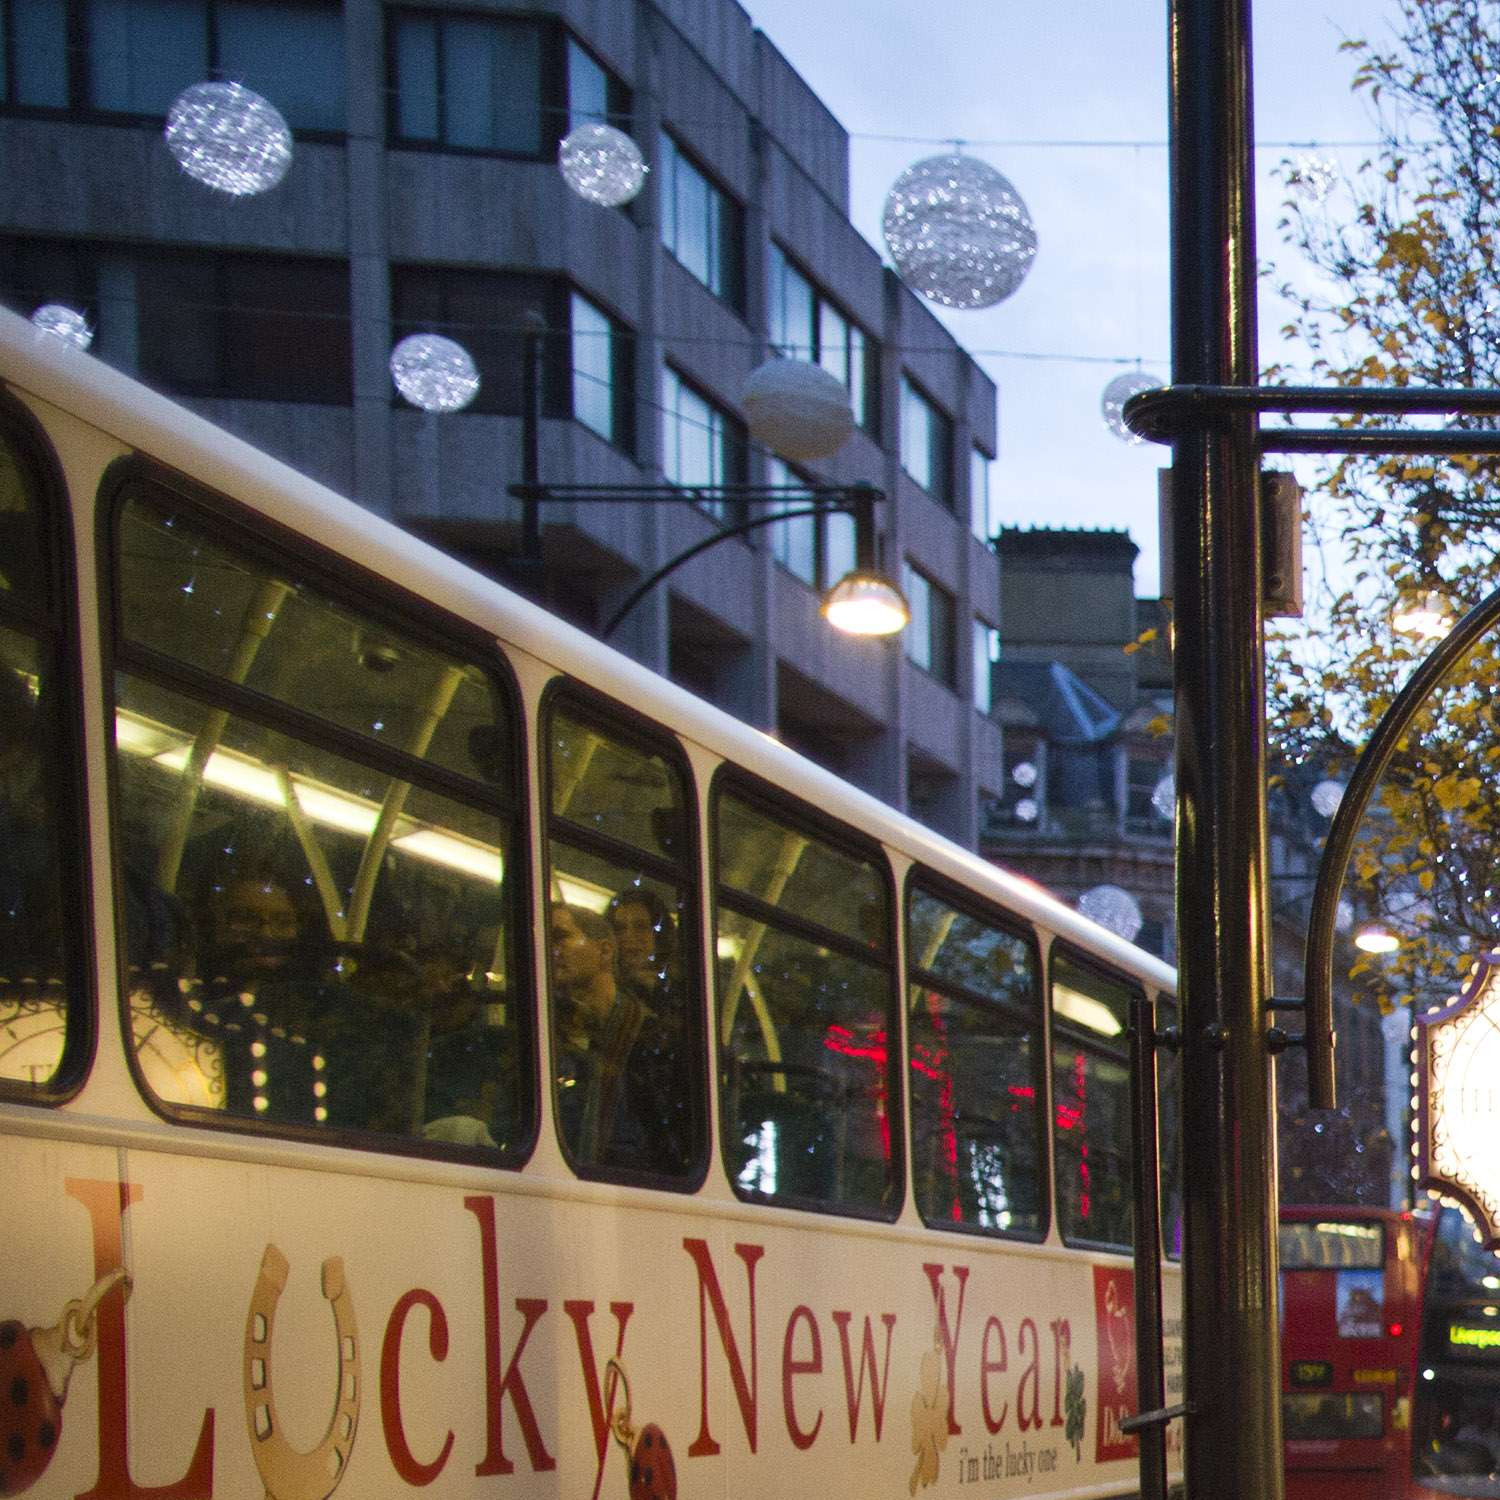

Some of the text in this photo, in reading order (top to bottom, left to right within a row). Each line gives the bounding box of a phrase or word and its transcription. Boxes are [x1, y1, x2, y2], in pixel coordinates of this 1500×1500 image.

[684, 1237, 896, 1459] New
[922, 1263, 1071, 1436] Year
[983, 1444, 1002, 1480] the
[1005, 1440, 1036, 1484] lucky
[1037, 1450, 1057, 1472] one
